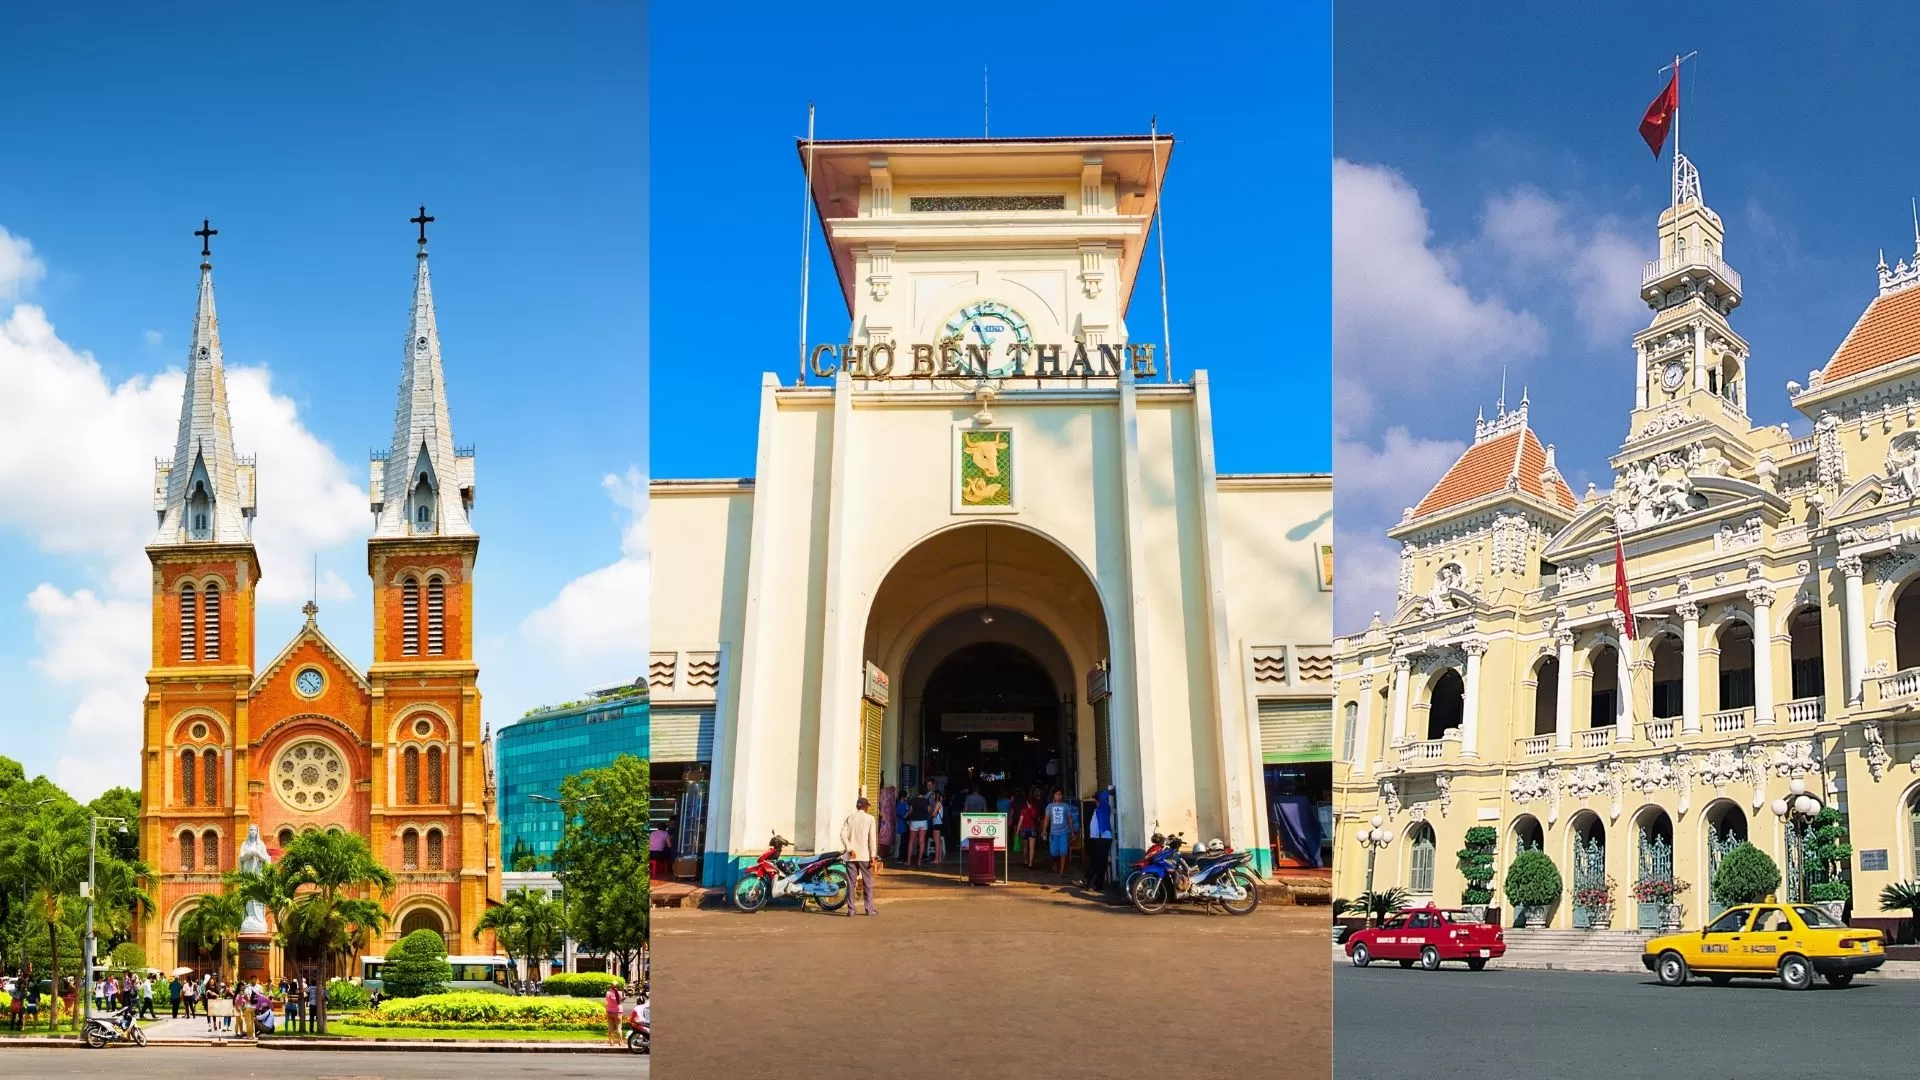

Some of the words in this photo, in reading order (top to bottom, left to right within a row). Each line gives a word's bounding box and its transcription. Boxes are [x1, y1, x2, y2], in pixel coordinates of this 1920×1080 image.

[811, 339, 897, 382] CHỢ
[910, 332, 990, 377] BẾN
[1006, 335, 1157, 377] THÀNH
